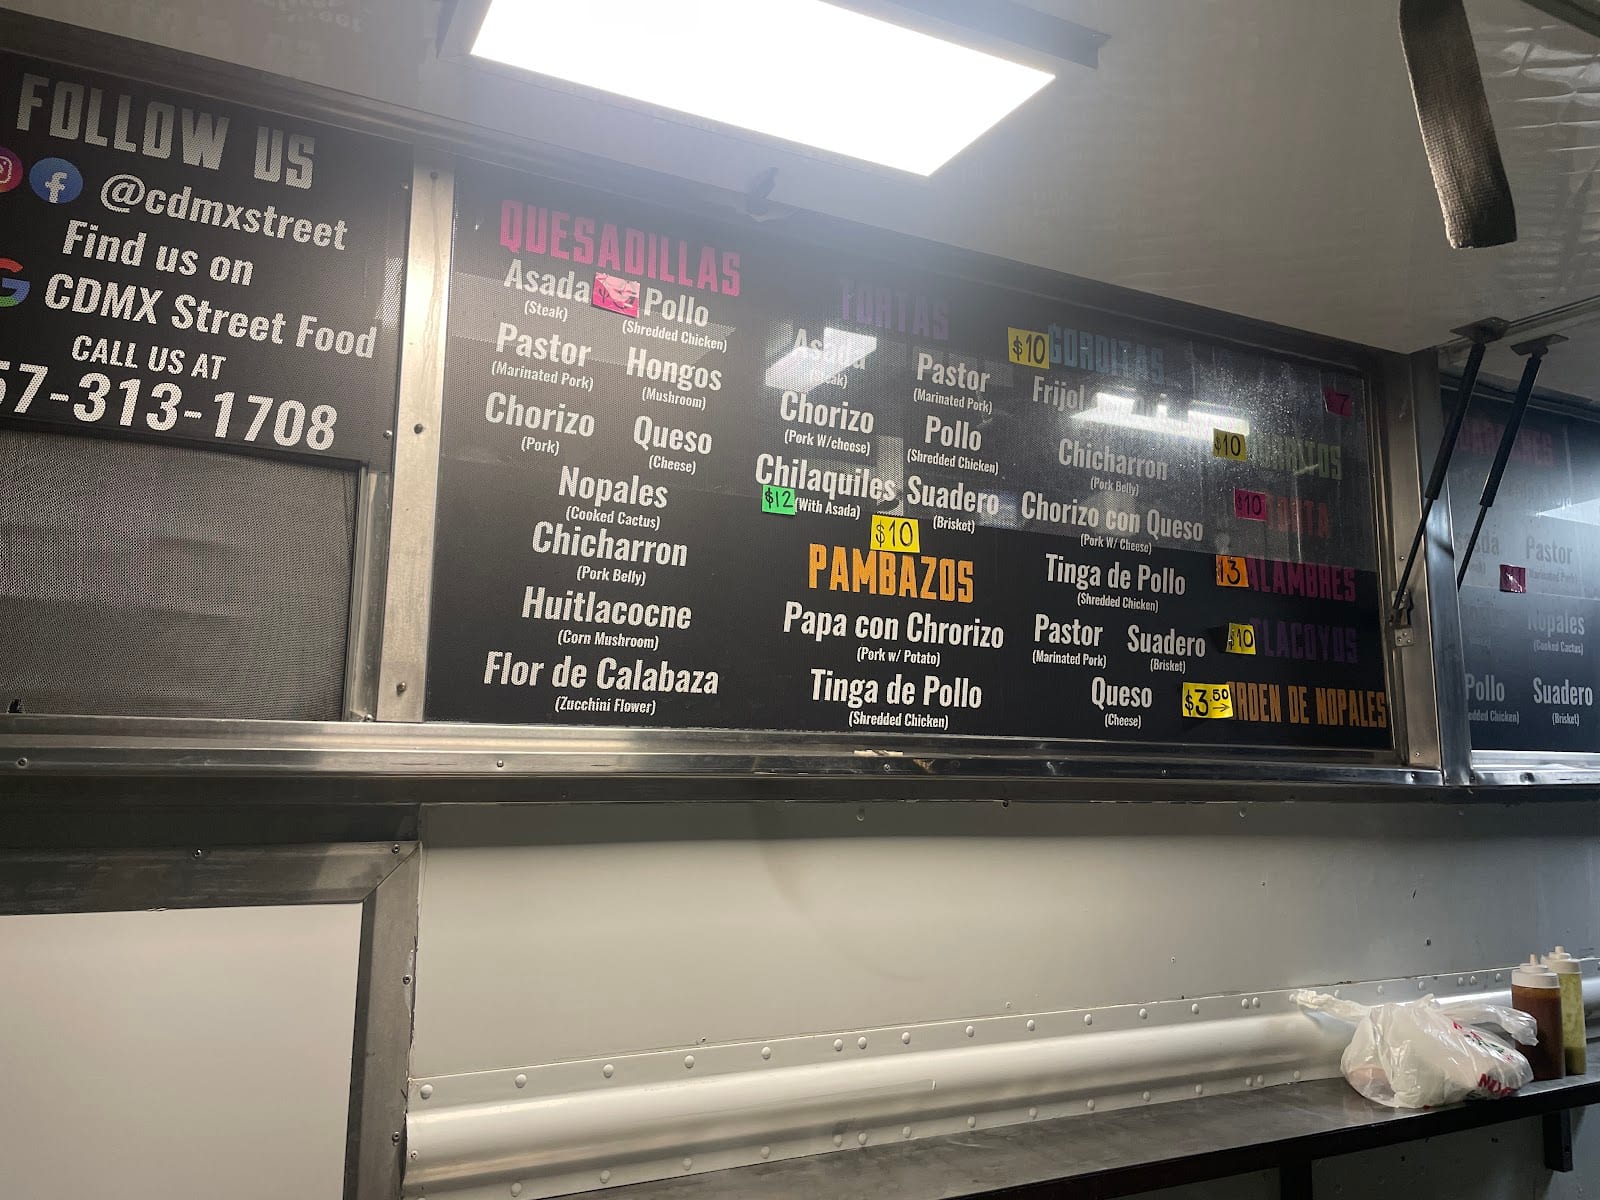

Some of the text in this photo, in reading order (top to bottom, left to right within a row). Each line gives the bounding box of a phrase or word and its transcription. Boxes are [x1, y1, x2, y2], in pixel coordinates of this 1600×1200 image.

[16, 73, 316, 190] FOLLOW US
[100, 173, 348, 250] @cdmxstreet
[62, 219, 255, 286] Find us on
[500, 199, 740, 297] QUESADILLAS
[503, 259, 591, 304] Asada
[44, 273, 164, 325] CDMX
[171, 294, 287, 344] Street
[295, 315, 377, 359] Food
[524, 300, 568, 322] (Steak)
[644, 287, 709, 327] Pollo
[496, 322, 591, 367] Pastor
[622, 319, 728, 353] (Shredded Chicken)
[1013, 334, 1046, 365] $10
[71, 334, 227, 380] CALL US AT
[626, 346, 722, 391] Hongos
[917, 352, 990, 392] Pastor
[491, 360, 594, 392] (Marinated Pork)
[642, 386, 706, 410] (Mushroom)
[913, 387, 993, 415] (Marinated Pork)
[1033, 375, 1084, 412] Frijol
[485, 391, 595, 437] Chorizo
[780, 390, 874, 434] Chorizo
[521, 436, 560, 456] (Pork)
[633, 415, 712, 455] Queso
[784, 428, 813, 447] (Pork
[925, 415, 982, 451] Pollo
[1214, 433, 1241, 457] $10
[648, 454, 696, 475] (Cheese)
[907, 448, 999, 475] (Shredded Chicken)
[1058, 438, 1168, 481] Chicharron
[558, 465, 669, 508] Nopales
[755, 453, 896, 501] Chilaquiles
[1090, 476, 1139, 497] (Pork Belly)
[764, 486, 794, 508] $12
[825, 501, 861, 520] Asada)
[907, 475, 1000, 516] Suadero
[1237, 494, 1262, 516] $10
[566, 505, 661, 531] (Cooked Cactus)
[933, 515, 975, 534] (Brisket)
[1021, 490, 1203, 542] Chorizo con Queso
[532, 521, 688, 567] Chicharron
[874, 521, 914, 548] $10
[1080, 533, 1104, 547] (Pork
[1119, 538, 1152, 555] Cheese)
[1526, 536, 1573, 565] Pastor
[576, 565, 647, 586] (Pork Belly)
[808, 543, 974, 604] PAMBAZOS
[1046, 553, 1186, 595] Tinga de Pollo
[1077, 592, 1159, 613] (Shredded Chicken)
[557, 629, 659, 651] (Corn Mushroom)
[783, 601, 1004, 649] Papa con Chrorizo
[1034, 613, 1103, 647] Pastor
[1528, 611, 1585, 637] Nopales
[857, 646, 940, 667] (Pork w/ Potato)
[1127, 624, 1206, 658] Suadero
[484, 650, 719, 694] Flor de Calabaza
[1032, 650, 1107, 668] (Marinated Pork)
[1150, 658, 1186, 674] (Brisket)
[810, 668, 982, 709] Tinga de Pollo
[1091, 676, 1152, 710] Queso
[1465, 673, 1505, 702] Pollo
[1533, 677, 1593, 706] Suadero
[555, 695, 656, 716] (Zucchini Flower)
[849, 711, 949, 731] (Shredded Chicken)
[1104, 713, 1142, 729] (Cheese)
[1287, 684, 1310, 725] DE
[1315, 687, 1387, 728] NOPALES
[1552, 712, 1580, 727] (Brisket)
